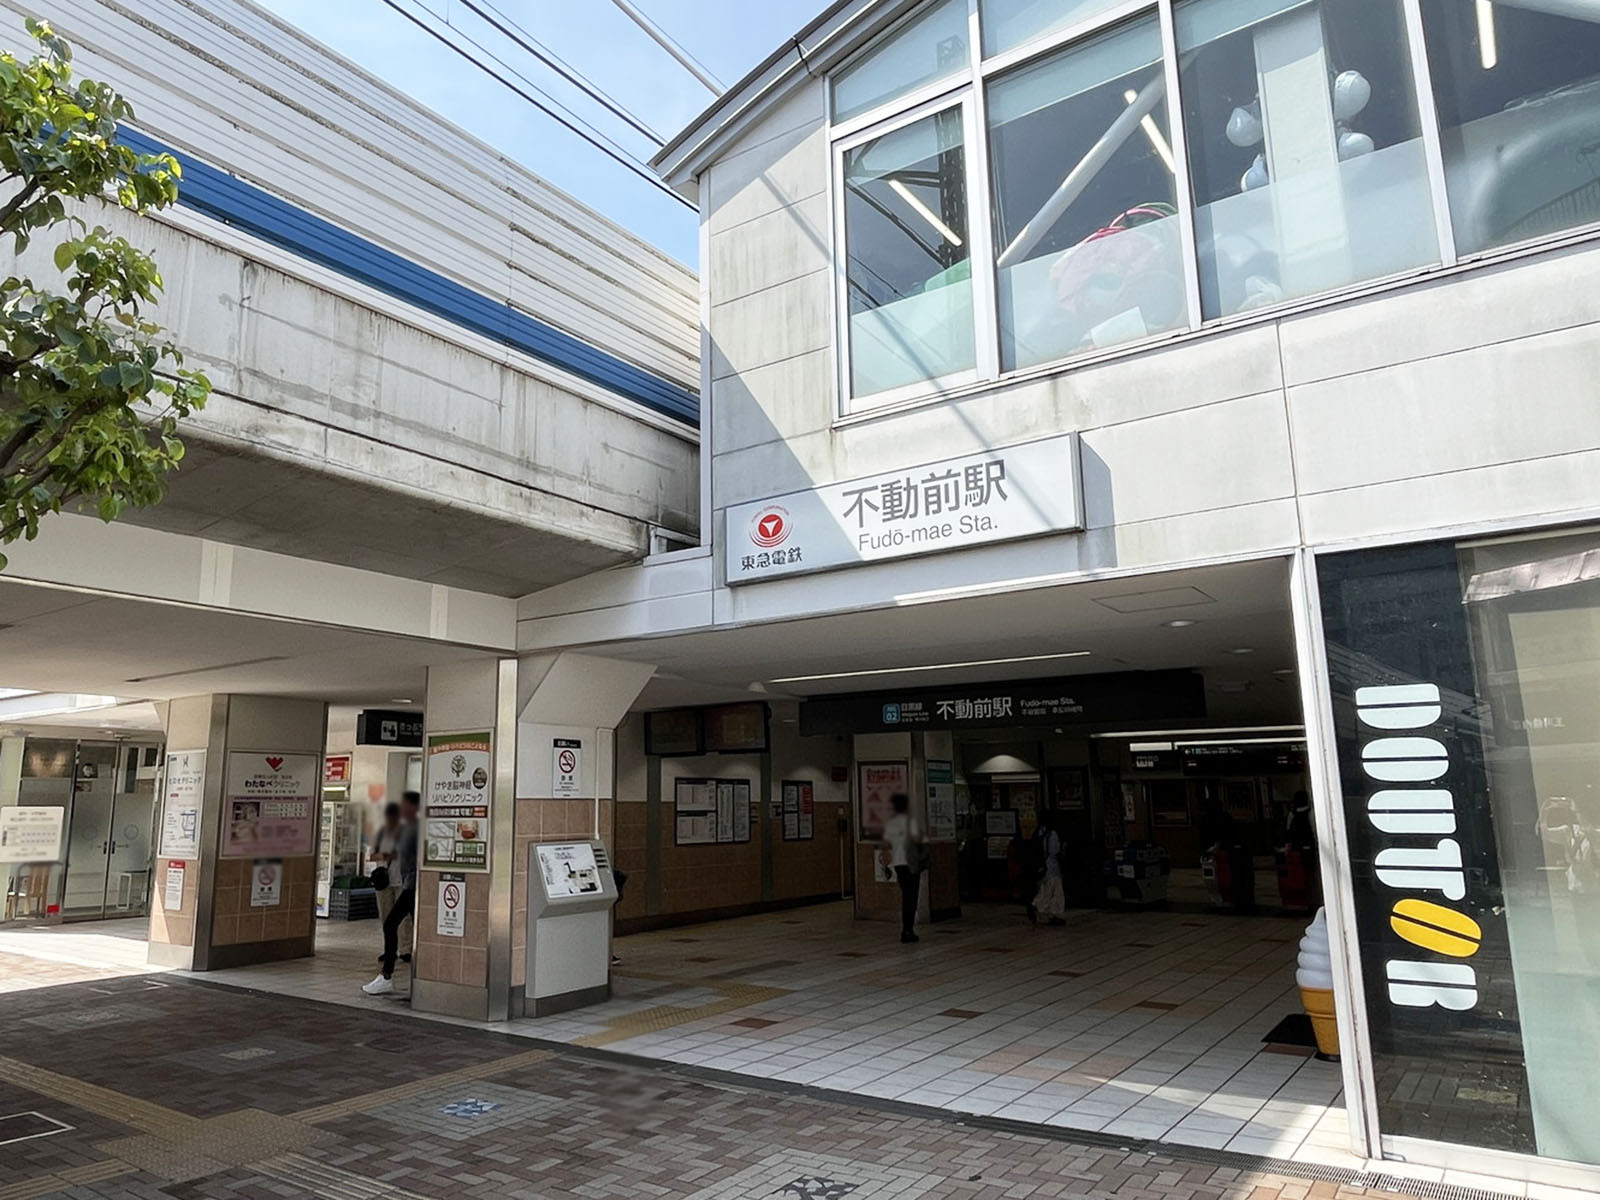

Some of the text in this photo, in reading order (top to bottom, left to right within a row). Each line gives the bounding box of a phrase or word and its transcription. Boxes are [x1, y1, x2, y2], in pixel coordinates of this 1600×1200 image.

[841, 459, 1008, 529] 不動前駅
[858, 514, 999, 552] Fudō-mae Sta.
[740, 546, 804, 572] 東急電鉄
[886, 712, 898, 721] 02
[936, 696, 1013, 721] 不動前駅
[1355, 682, 1482, 1012] DOUTOR
